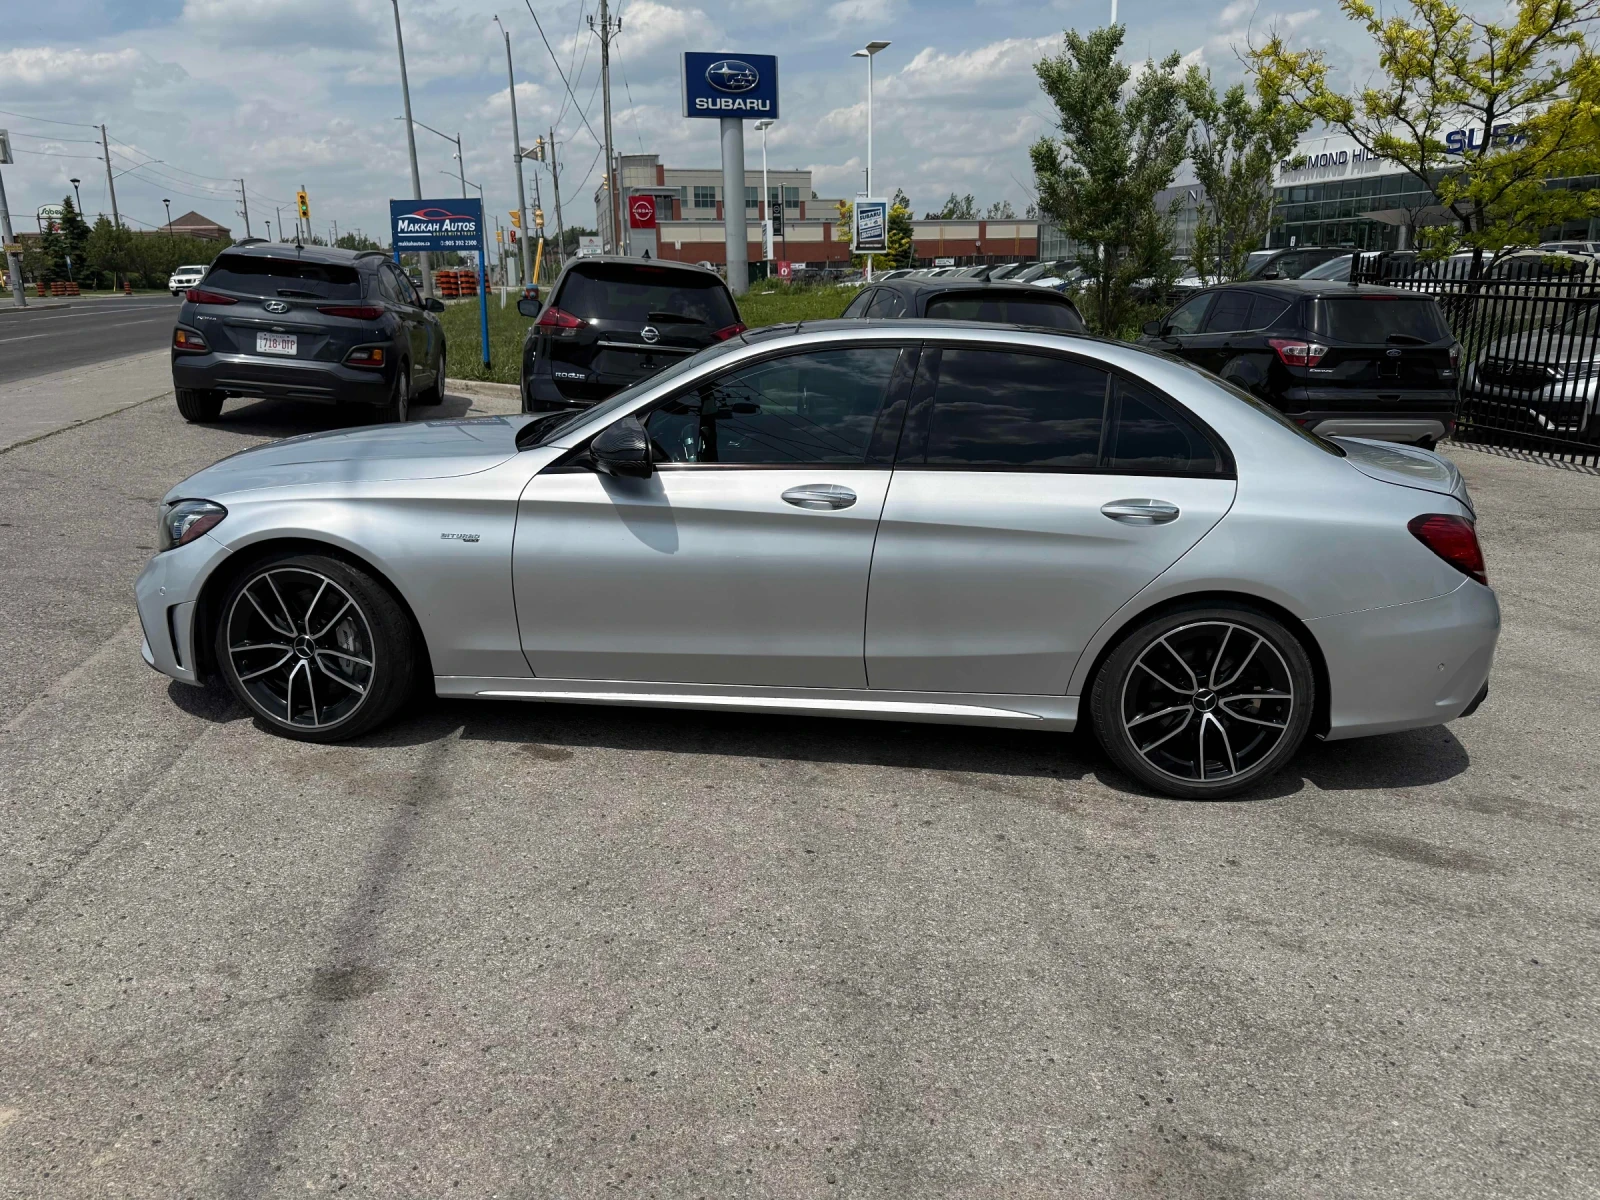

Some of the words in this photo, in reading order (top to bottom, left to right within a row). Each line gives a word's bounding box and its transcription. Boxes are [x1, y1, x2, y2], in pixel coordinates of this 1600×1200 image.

[695, 97, 771, 111] SUBARU
[1280, 151, 1348, 173] RIMOND
[860, 211, 881, 221] SUBARU
[398, 220, 440, 232] MAKKAH
[442, 219, 476, 231] AUTOS
